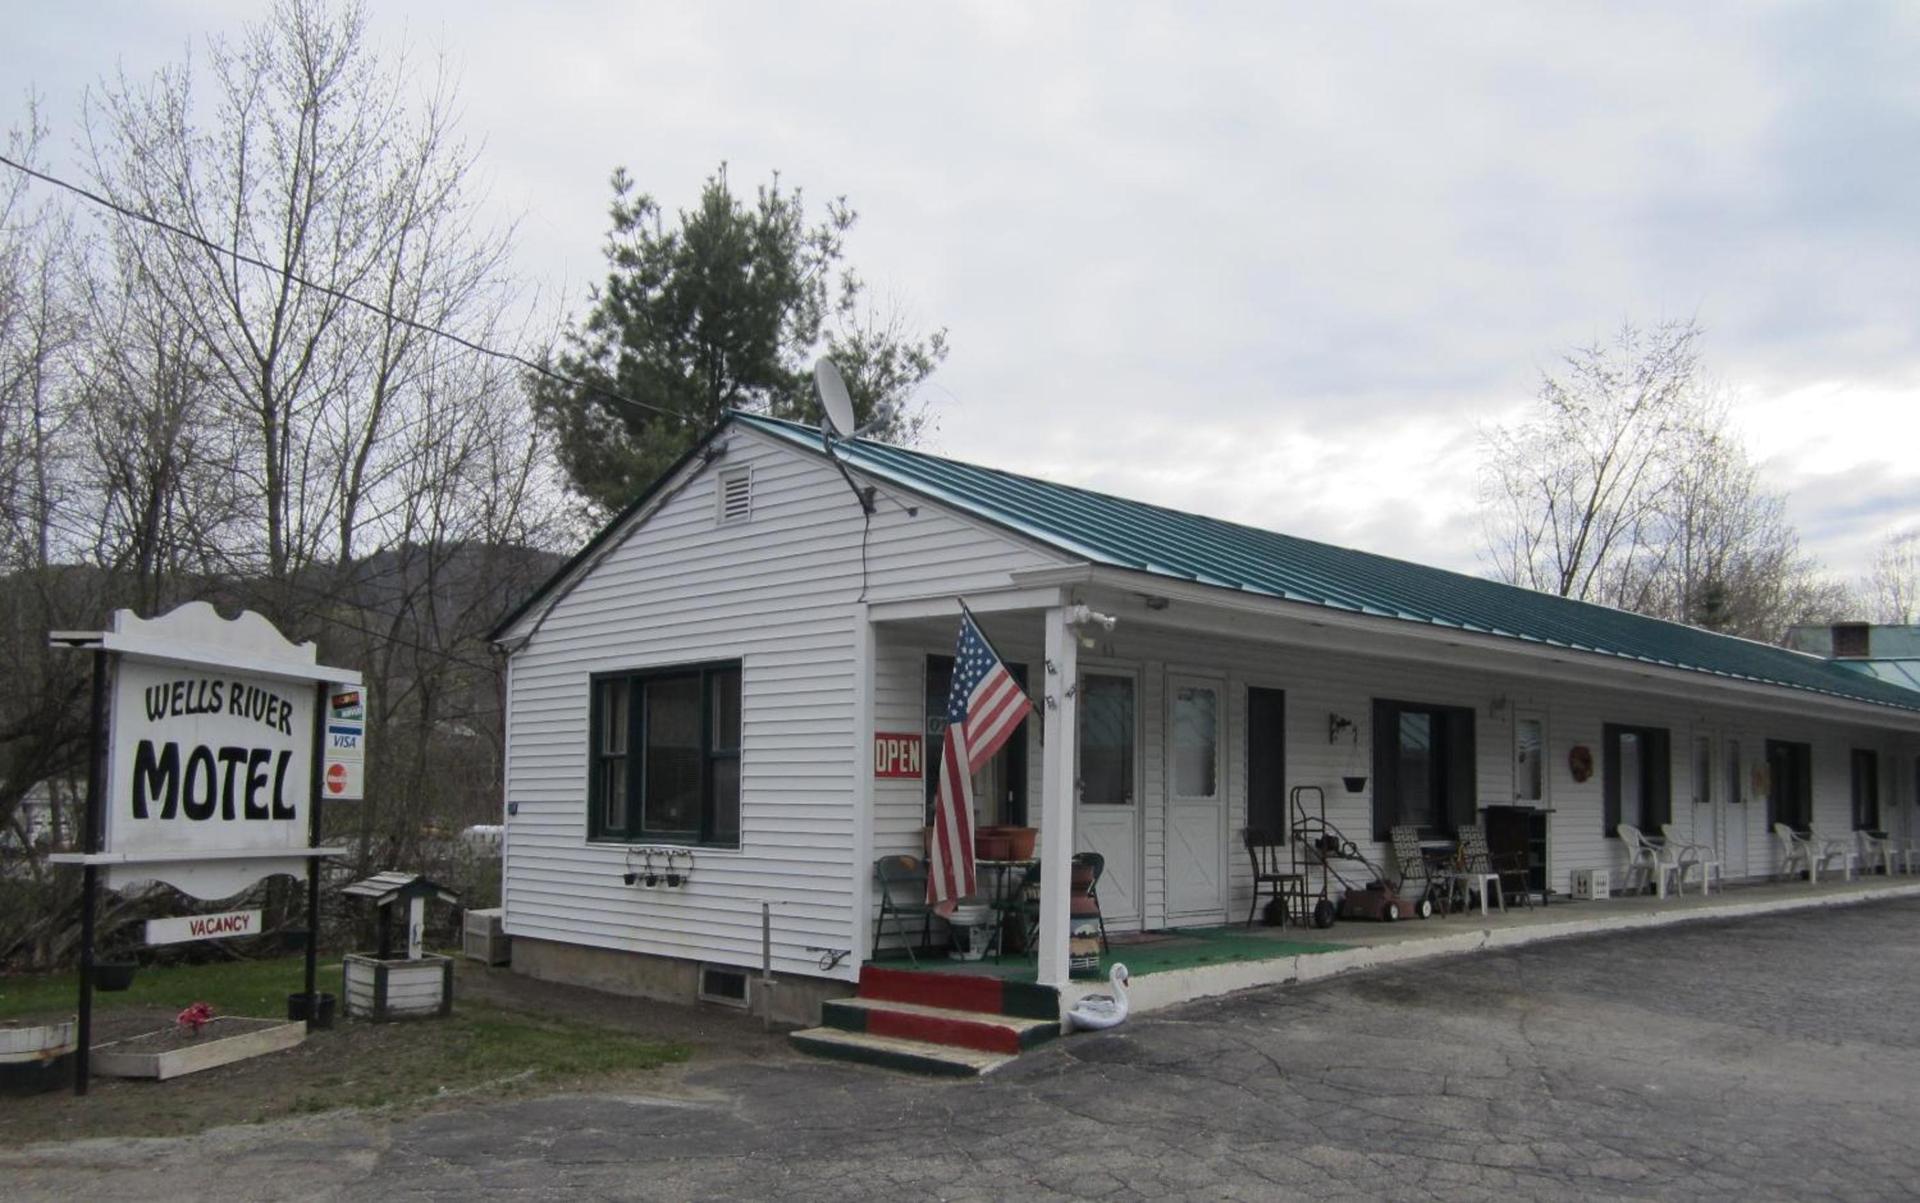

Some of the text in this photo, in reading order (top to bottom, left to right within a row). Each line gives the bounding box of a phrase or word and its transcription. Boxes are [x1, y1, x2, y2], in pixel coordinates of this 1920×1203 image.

[145, 679, 293, 736] WELLS RIVER
[333, 734, 356, 748] VISA
[876, 739, 920, 773] OPEN
[132, 739, 296, 821] MOTEL
[190, 914, 250, 936] VACANCY
